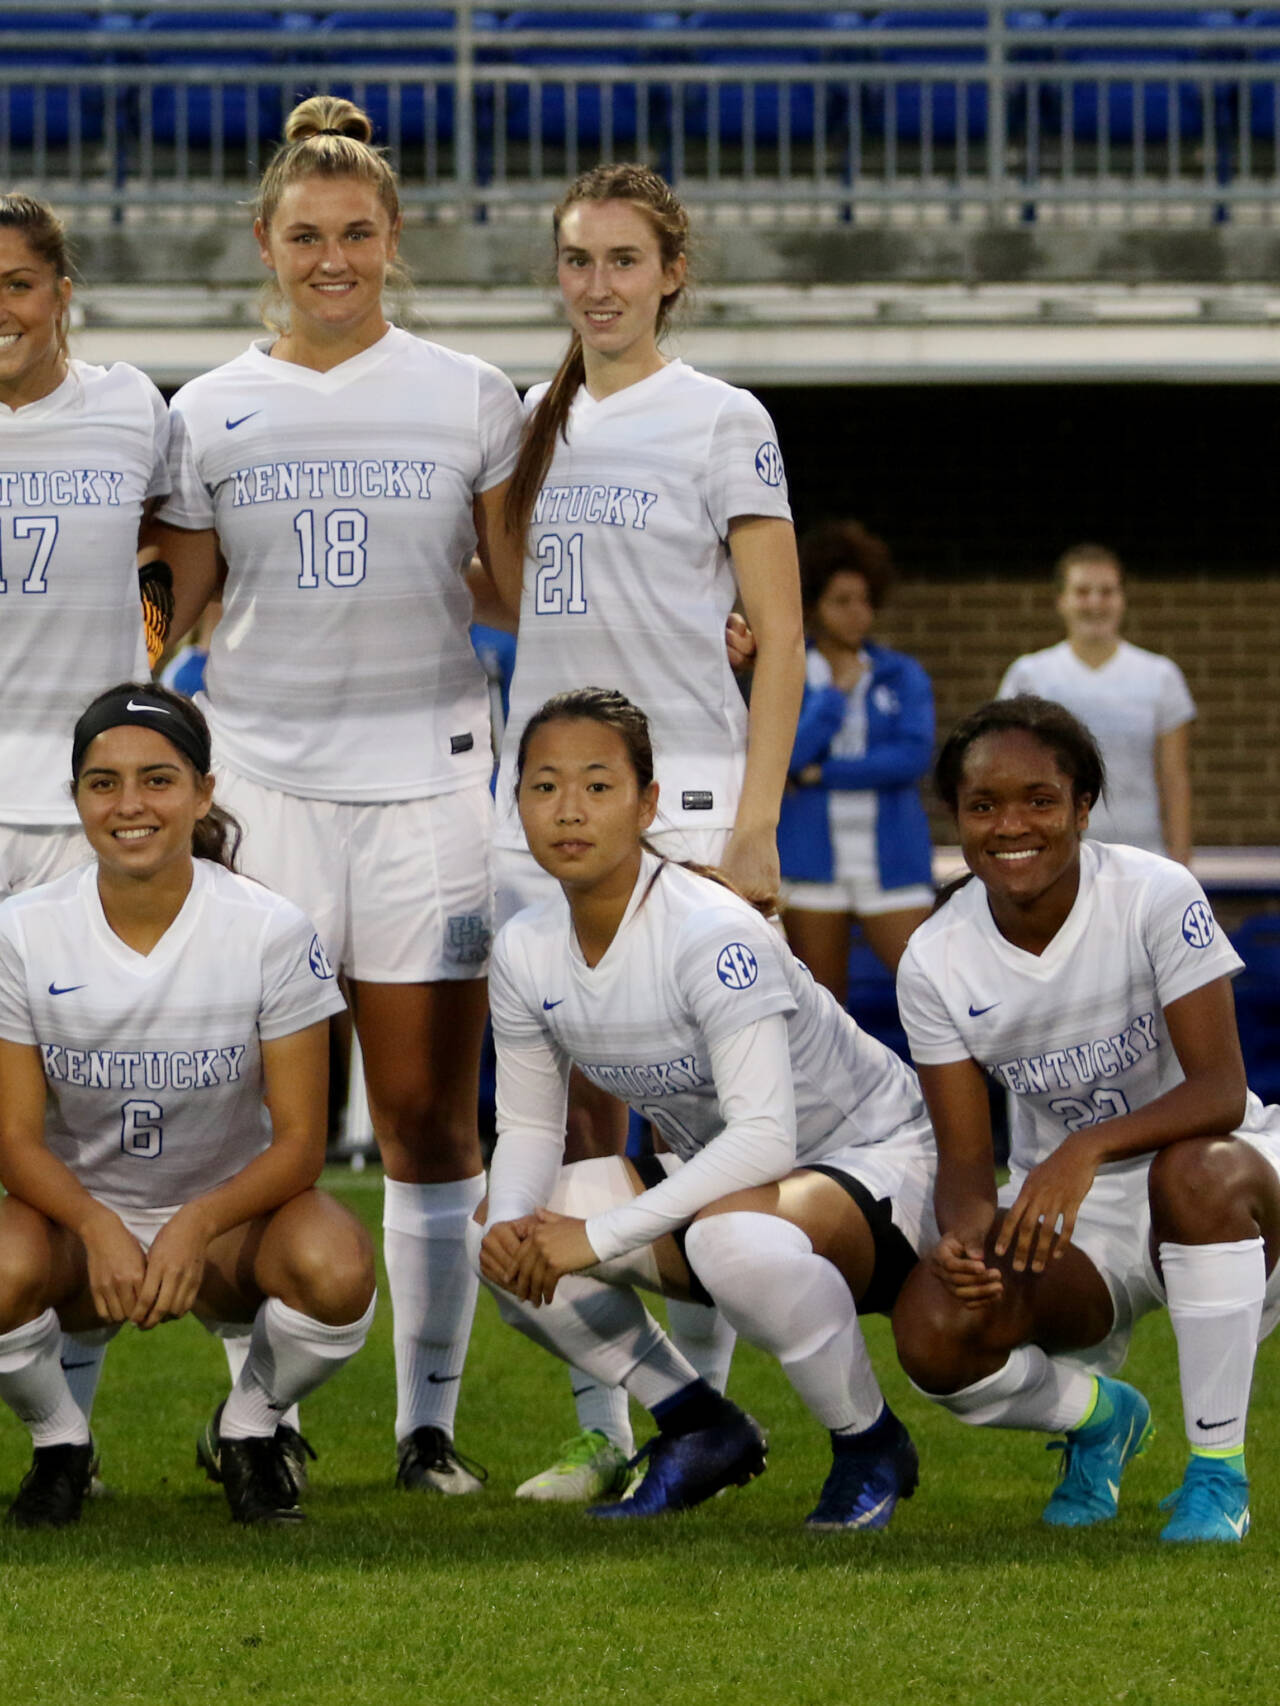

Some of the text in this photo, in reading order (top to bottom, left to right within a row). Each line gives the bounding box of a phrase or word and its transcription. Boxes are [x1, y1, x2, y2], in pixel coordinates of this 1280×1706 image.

[230, 460, 436, 507] KENTUCKY
[530, 485, 658, 530] NTUCKY
[293, 508, 368, 589] 18
[535, 533, 587, 615] 21
[1183, 901, 1214, 948] SEC
[717, 943, 757, 989] SEC
[39, 1043, 246, 1090] KENTUCKY
[985, 1013, 1160, 1094] ENTUCKY
[122, 1099, 163, 1159] 6
